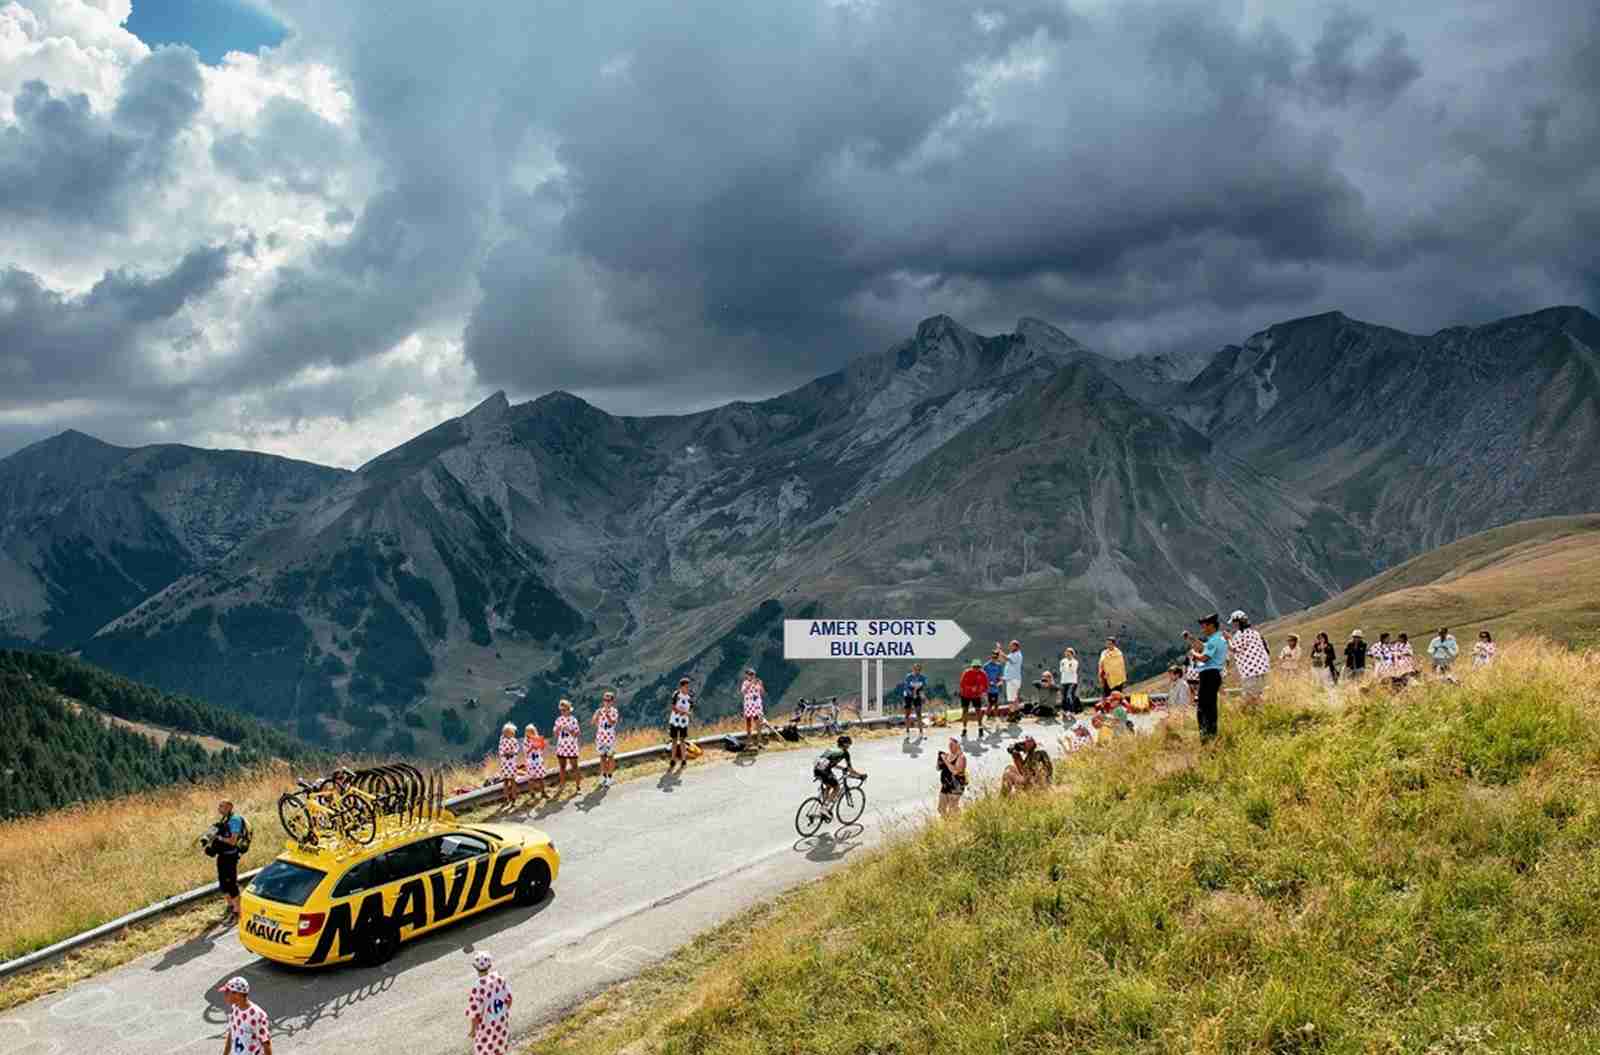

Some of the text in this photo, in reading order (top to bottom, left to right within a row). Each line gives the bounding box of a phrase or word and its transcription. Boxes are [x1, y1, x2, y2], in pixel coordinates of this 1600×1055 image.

[810, 621, 936, 636] AMER SPORTS
[831, 641, 914, 656] BULGARIA
[305, 847, 522, 965] MAVIC
[245, 919, 293, 945] MAVIC
